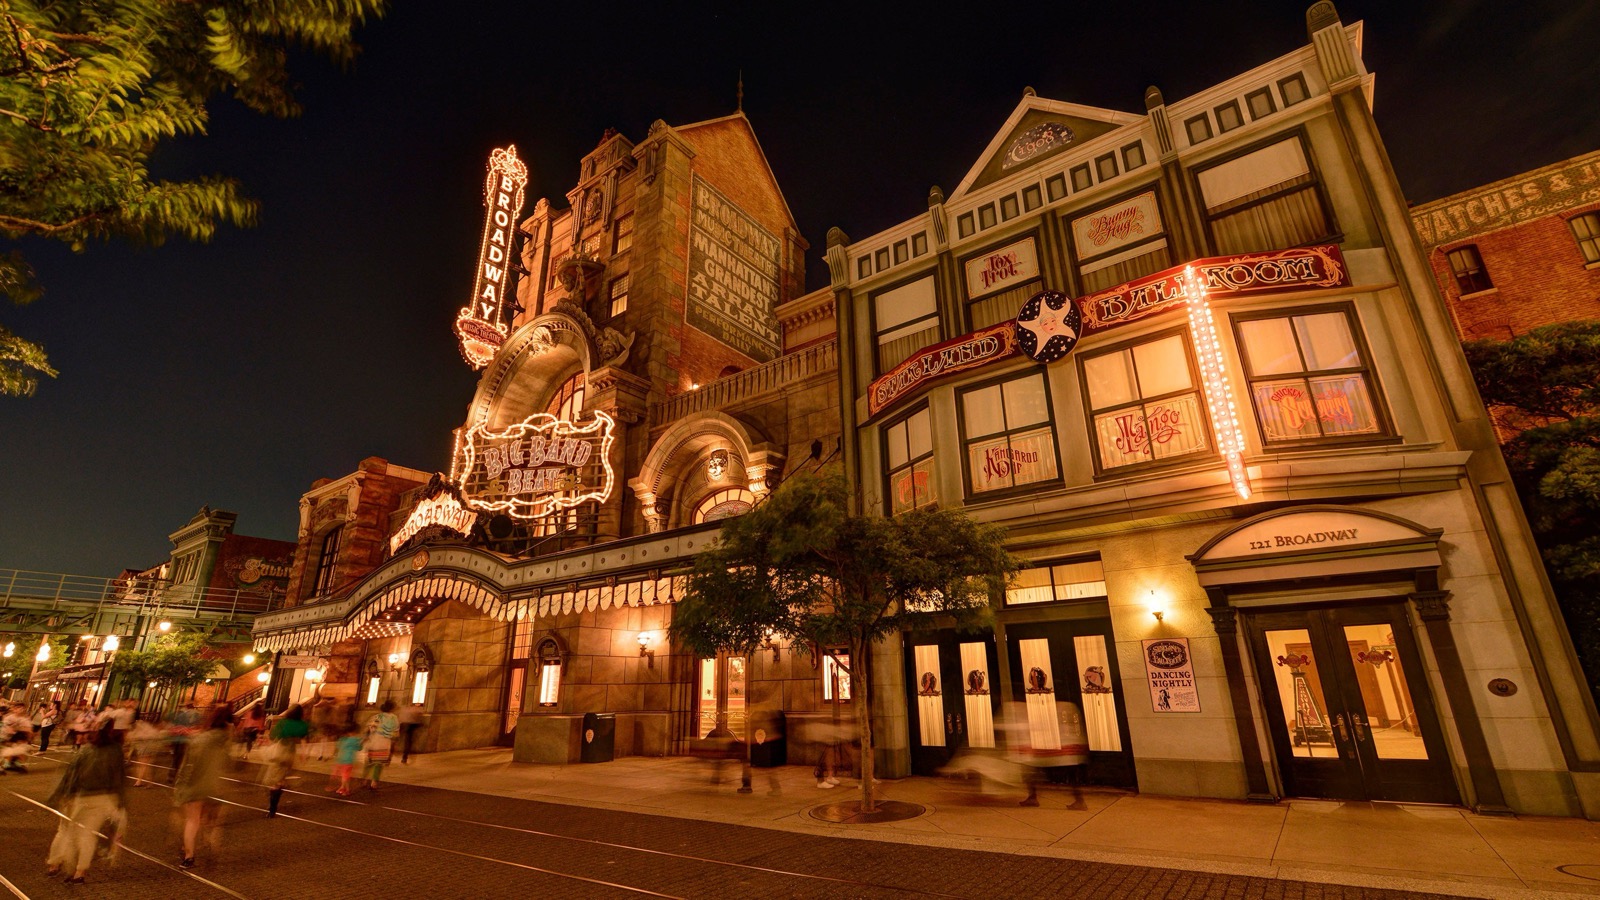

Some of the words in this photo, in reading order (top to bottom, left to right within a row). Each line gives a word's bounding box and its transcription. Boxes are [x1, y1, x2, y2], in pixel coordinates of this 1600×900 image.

[1549, 173, 1573, 192] &
[695, 208, 733, 248] MUSIC
[696, 184, 779, 262] BROADWAY
[480, 175, 514, 320] BROADWAY
[694, 231, 779, 302] MANHATTAN'S
[692, 271, 769, 325] ARRAY
[704, 258, 770, 314] GRANDEST
[692, 281, 779, 344] TALENT
[695, 304, 776, 359] PERFORMANCES
[722, 331, 752, 354] DAILY
[1271, 387, 1304, 402] CHICKEN
[1115, 406, 1181, 455] Tango
[482, 438, 525, 481] BIG
[527, 435, 592, 468] BAND
[506, 468, 561, 496] BEAT
[397, 504, 471, 545] BROADWAY
[1249, 540, 1272, 550] 121
[1274, 528, 1358, 548] BROADWAY
[1150, 671, 1191, 680] DANCING
[1152, 679, 1192, 688] NIGHTLY
